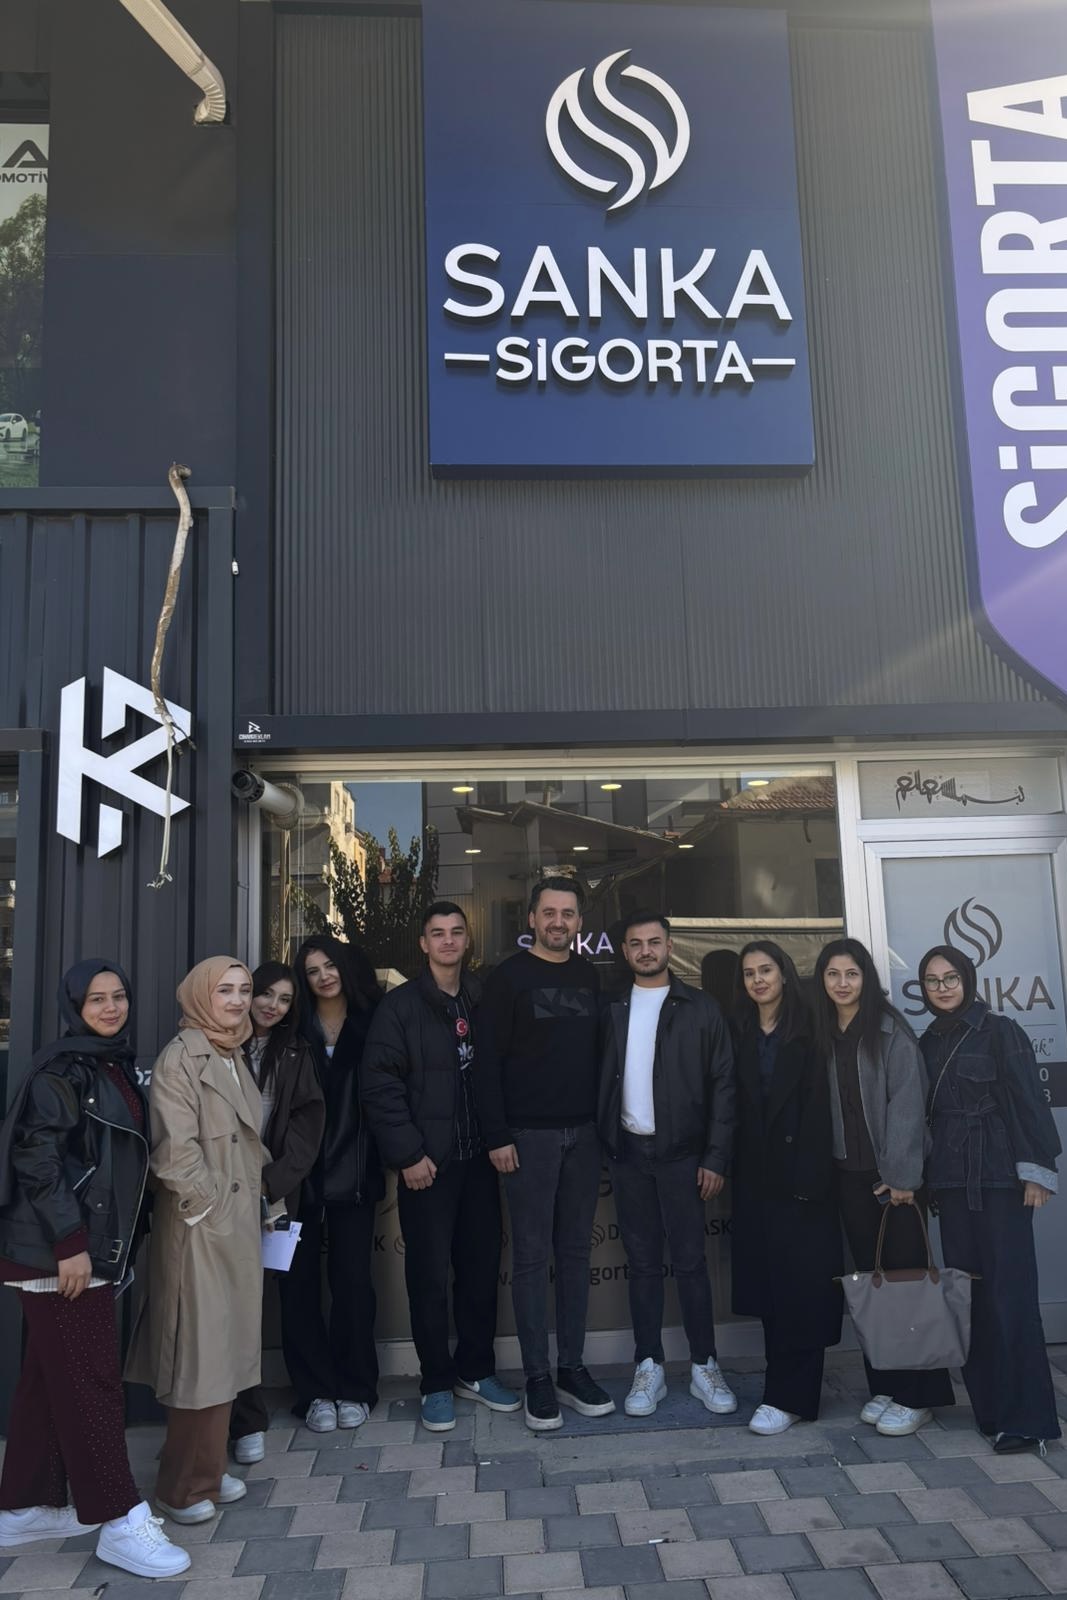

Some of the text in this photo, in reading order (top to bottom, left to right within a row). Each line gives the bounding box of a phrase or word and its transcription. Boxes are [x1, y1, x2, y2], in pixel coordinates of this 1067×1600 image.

[0, 171, 48, 183] MOTİ
[443, 243, 792, 320] SANKA
[516, 932, 615, 955] SKA
[902, 975, 1055, 1016] SKA
